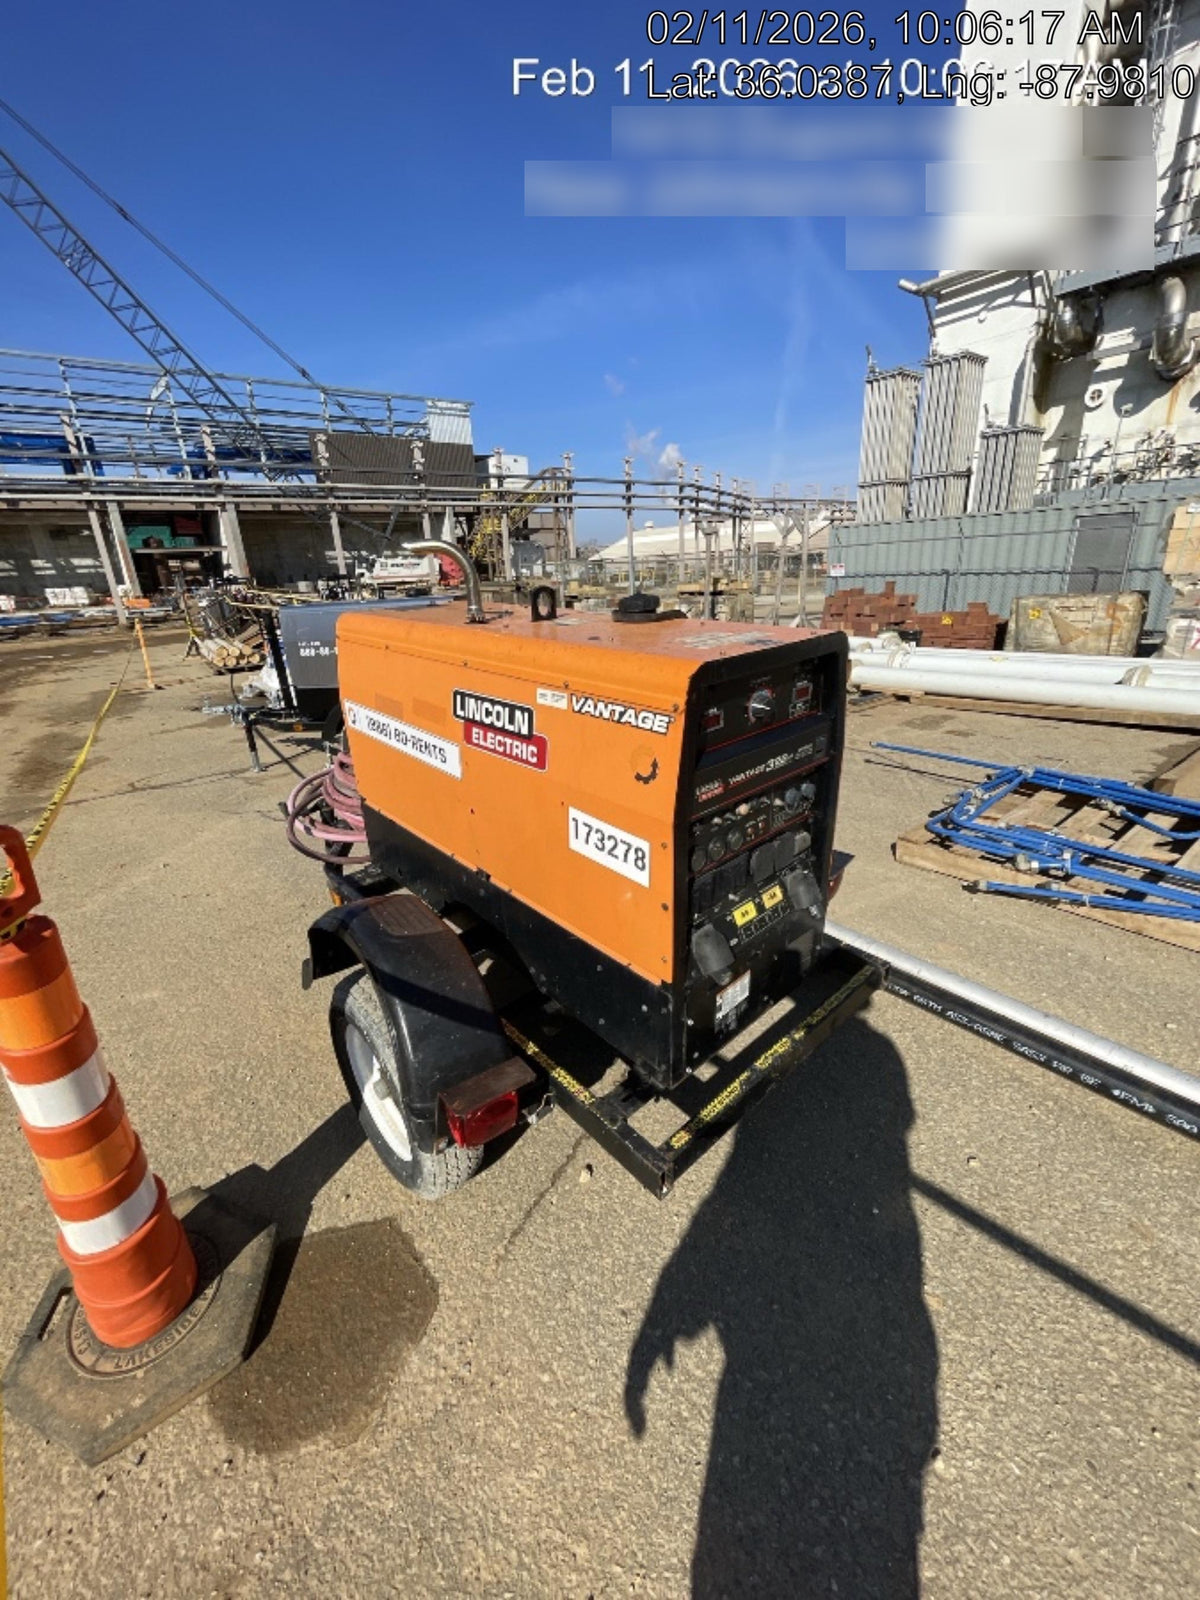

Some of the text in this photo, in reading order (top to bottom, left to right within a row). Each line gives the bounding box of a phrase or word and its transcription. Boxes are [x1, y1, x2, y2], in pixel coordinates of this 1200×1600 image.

[455, 694, 530, 736] LINCOLN
[570, 693, 671, 735] VANTAGE
[471, 726, 538, 764] ELECTRIC
[571, 817, 647, 872] 173278
